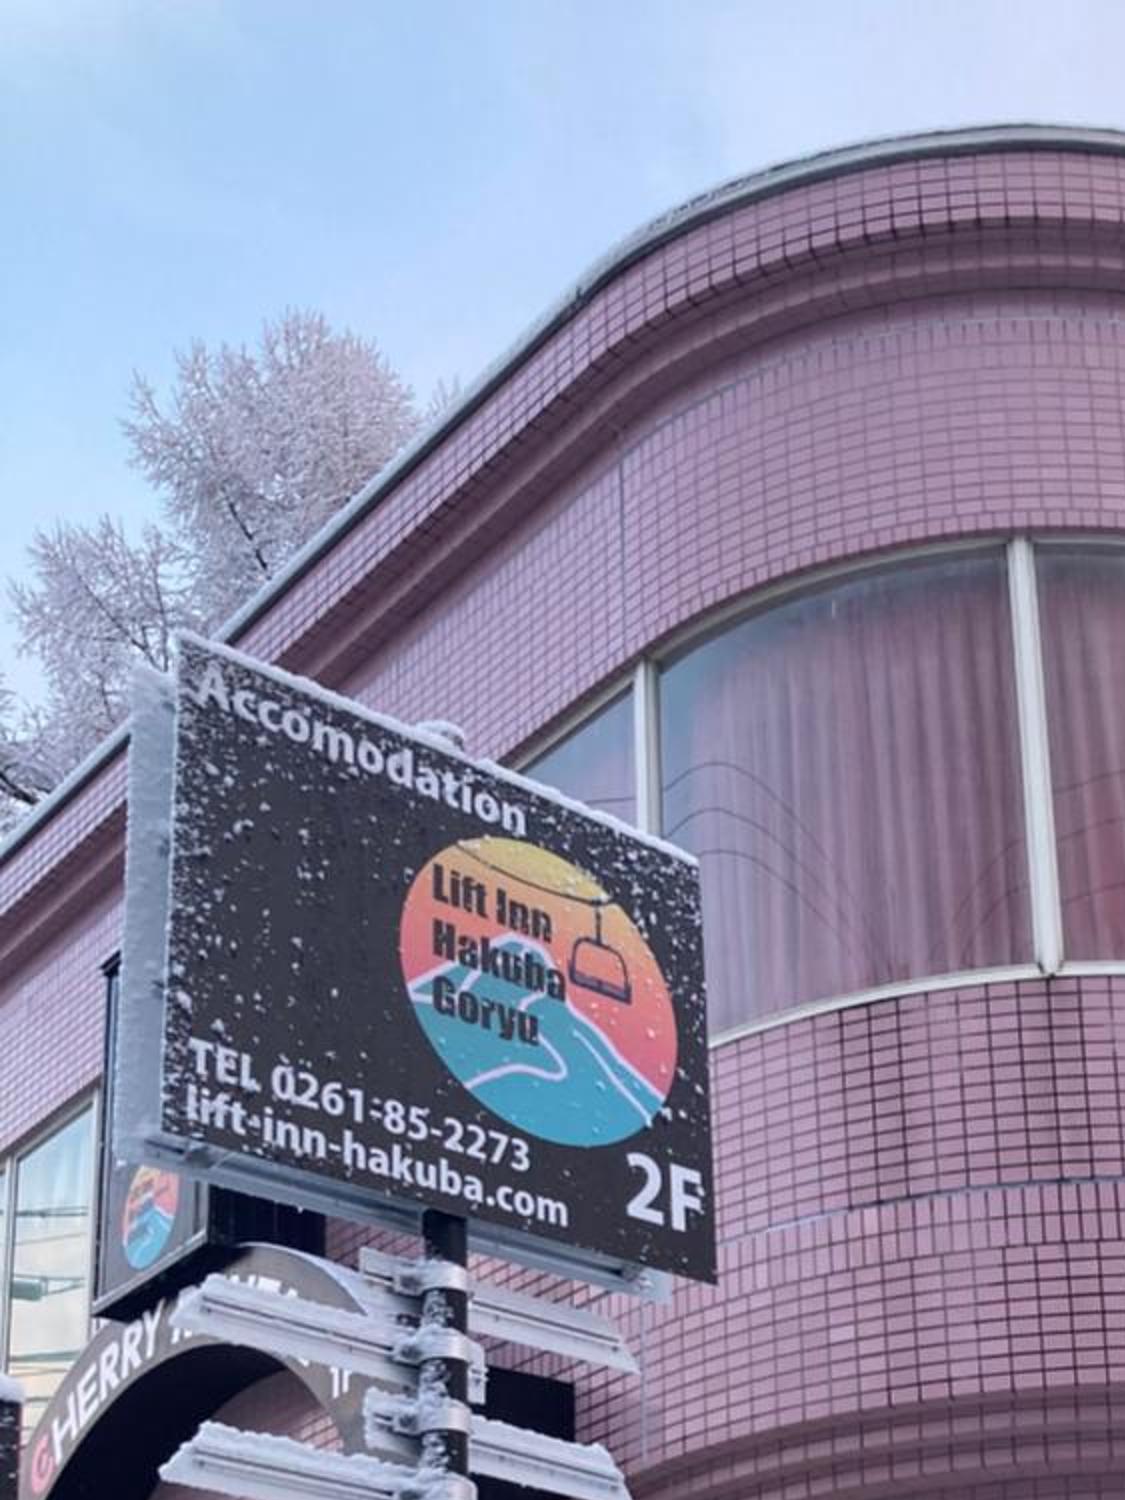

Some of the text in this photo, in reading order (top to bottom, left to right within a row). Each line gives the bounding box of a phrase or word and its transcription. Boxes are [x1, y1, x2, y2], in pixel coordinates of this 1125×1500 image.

[198, 666, 527, 836] Accomodation
[433, 863, 552, 943] Lift Inn
[433, 918, 566, 1001] Hakuba
[432, 975, 539, 1046] Goryu
[189, 1038, 531, 1172] TEL 0261-85-2273
[186, 1085, 569, 1228] lift-inn-hakuba.com
[626, 1152, 703, 1232] 2F
